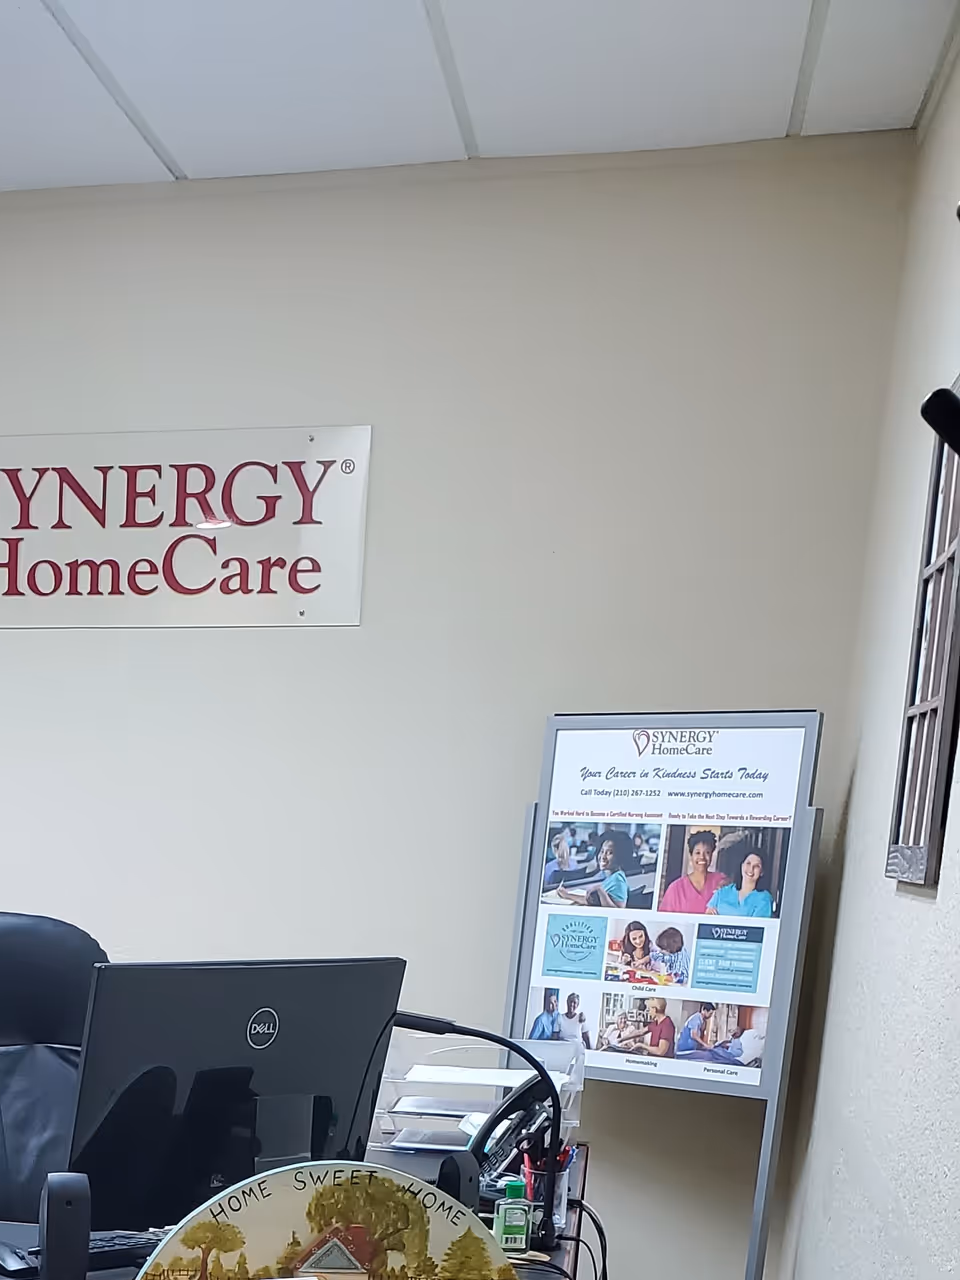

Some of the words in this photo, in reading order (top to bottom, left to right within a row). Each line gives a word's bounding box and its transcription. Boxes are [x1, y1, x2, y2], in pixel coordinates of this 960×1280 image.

[651, 730, 715, 744] SYNERGY
[651, 743, 713, 756] HomeCare
[580, 766, 601, 781] Your
[605, 766, 637, 780] Career
[640, 768, 650, 779] in
[653, 767, 697, 780] Kindness
[700, 768, 734, 780] Starts
[737, 767, 770, 783] Today
[580, 788, 593, 797] Call
[593, 788, 612, 798] Today
[613, 788, 630, 798] (210)
[631, 788, 661, 797] 267-1252
[667, 790, 764, 800] www.synergyhomecare.com
[632, 984, 644, 992] Child
[644, 985, 657, 993] Care
[251, 1023, 275, 1034] DELL
[625, 1058, 658, 1068] Homemaking
[703, 1067, 724, 1076] Personal
[724, 1068, 739, 1077] Care
[209, 1179, 273, 1225] HOME
[292, 1169, 379, 1191] SWEET
[401, 1181, 467, 1227] HOME
